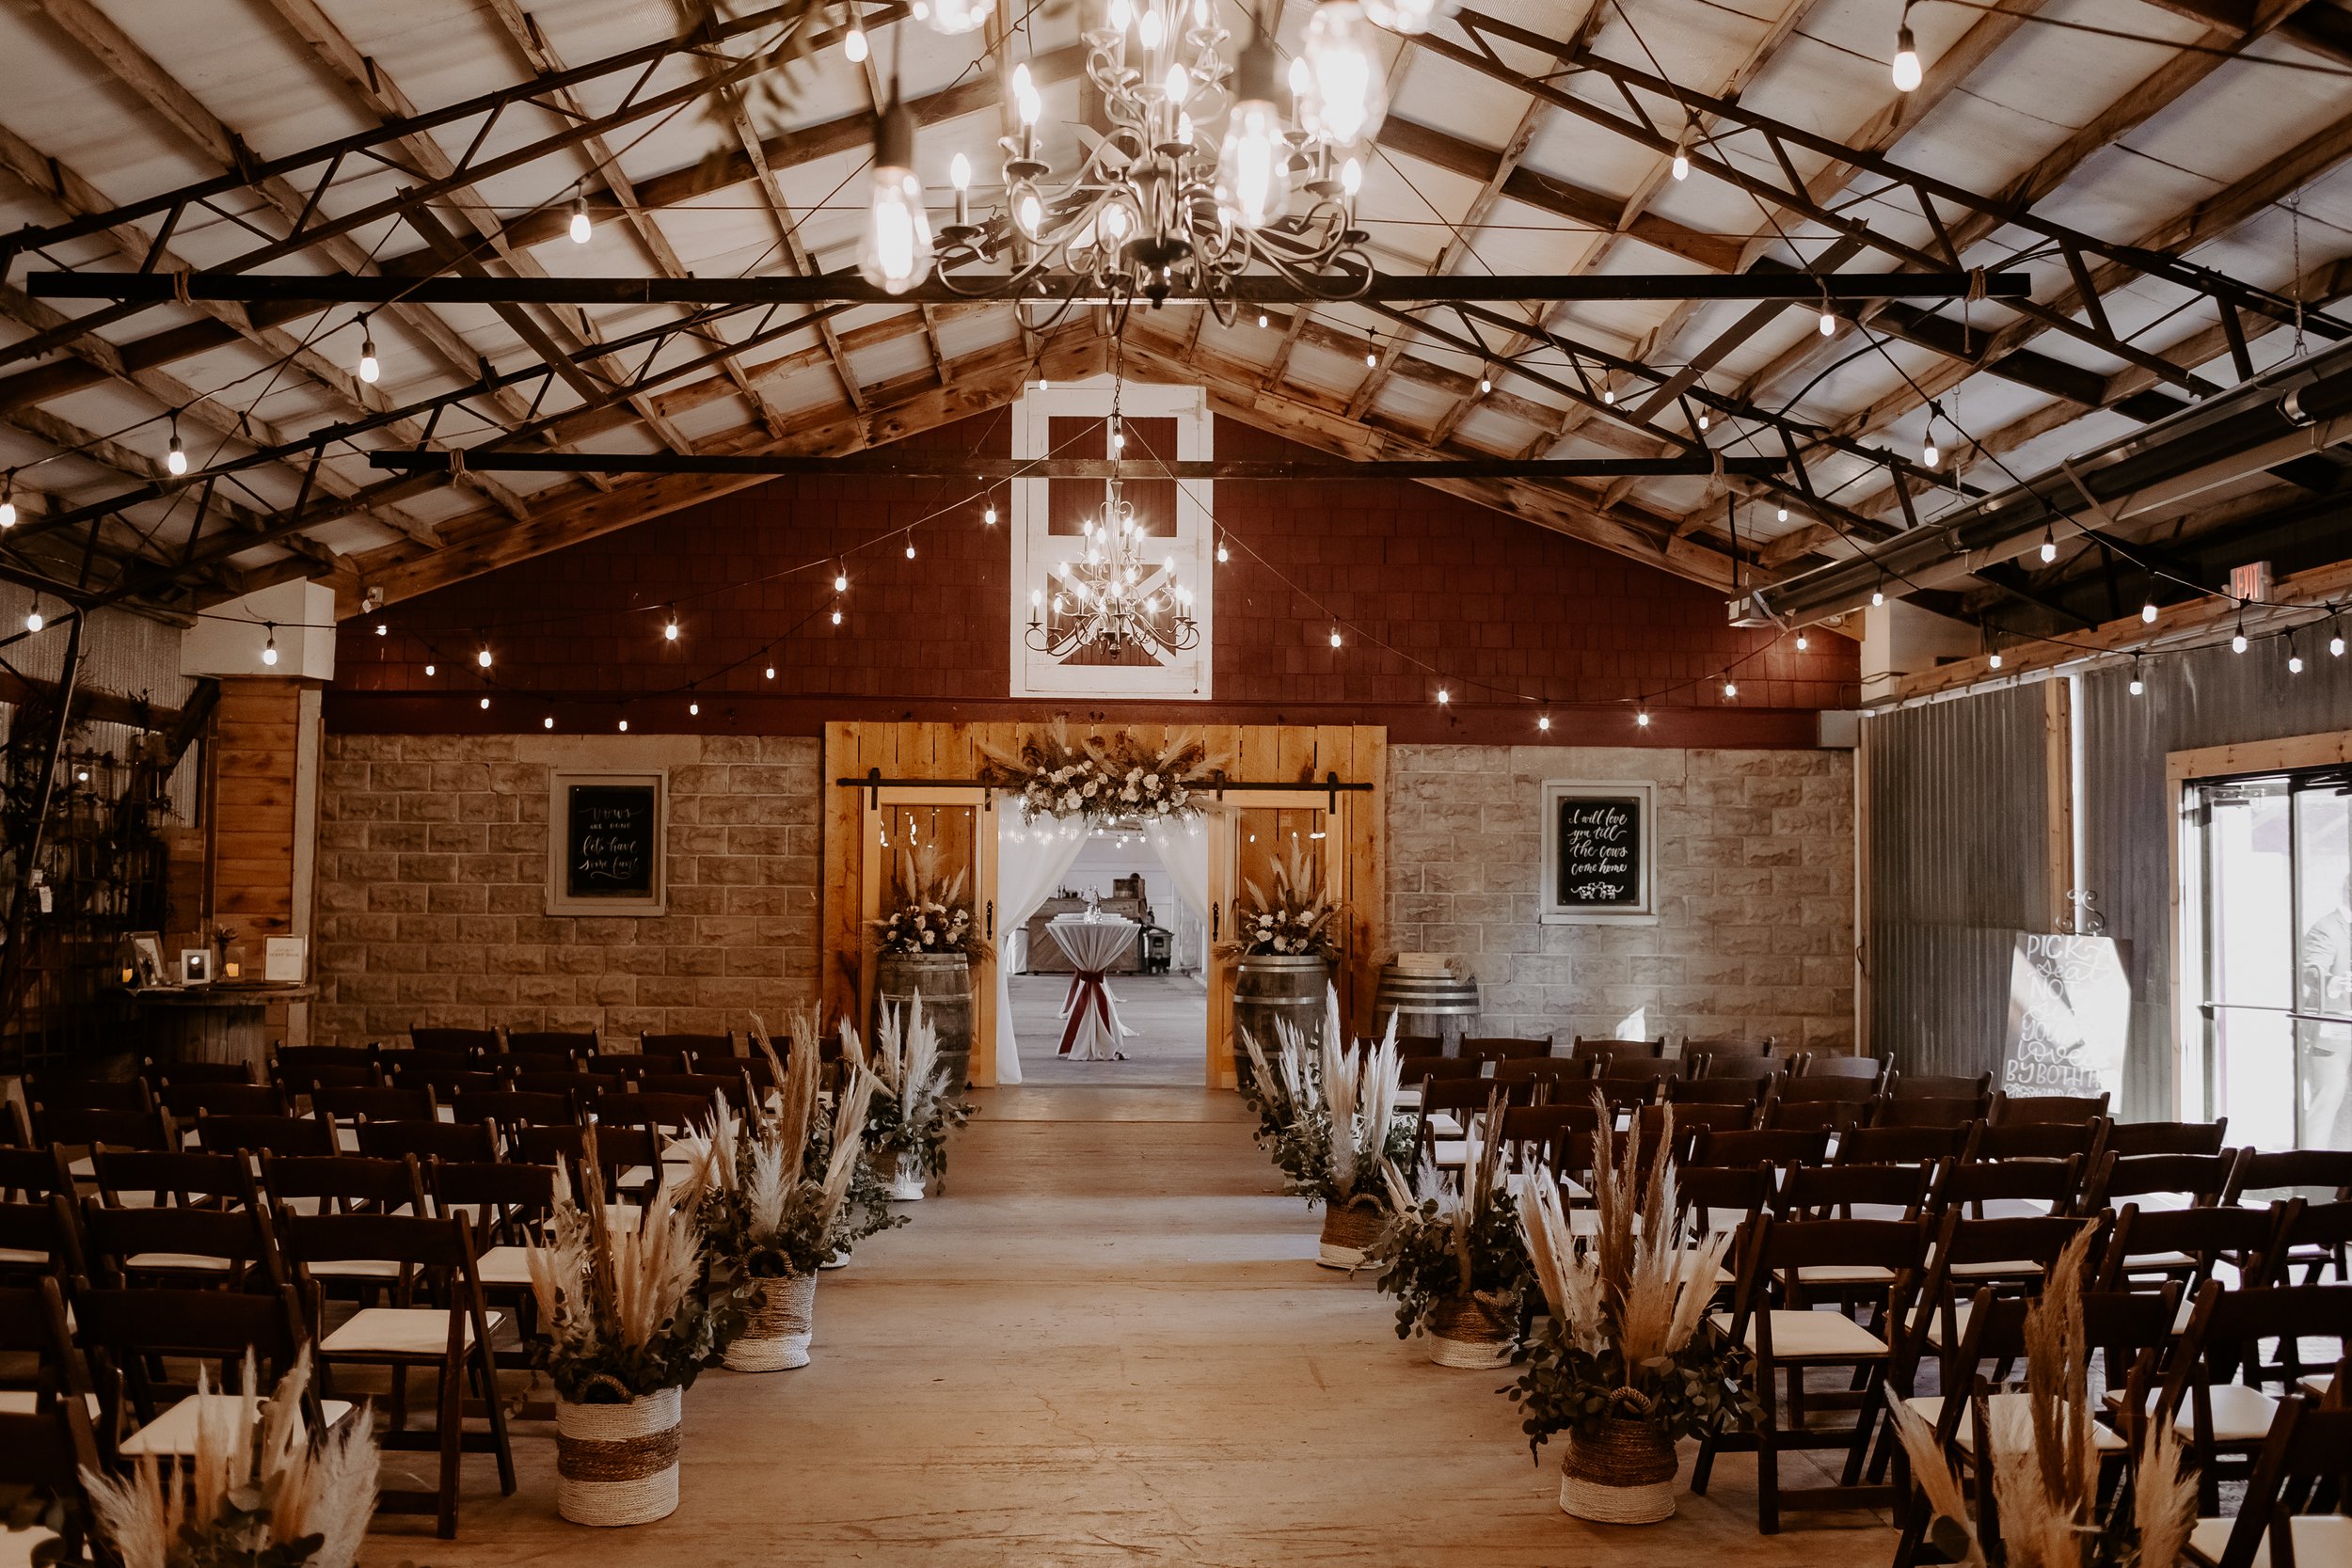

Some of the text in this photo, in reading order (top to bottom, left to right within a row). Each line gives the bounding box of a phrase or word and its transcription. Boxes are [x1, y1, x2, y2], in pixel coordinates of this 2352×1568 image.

[2236, 564, 2259, 599] EXIT
[1568, 807, 1628, 827] I will love
[1567, 824, 1628, 845] you till
[608, 836, 638, 854] have
[1570, 840, 1628, 858] the cows
[579, 859, 608, 871] some
[1571, 858, 1628, 876] come home
[2026, 934, 2090, 960] PICK
[2037, 1064, 2084, 1086] BOTH
